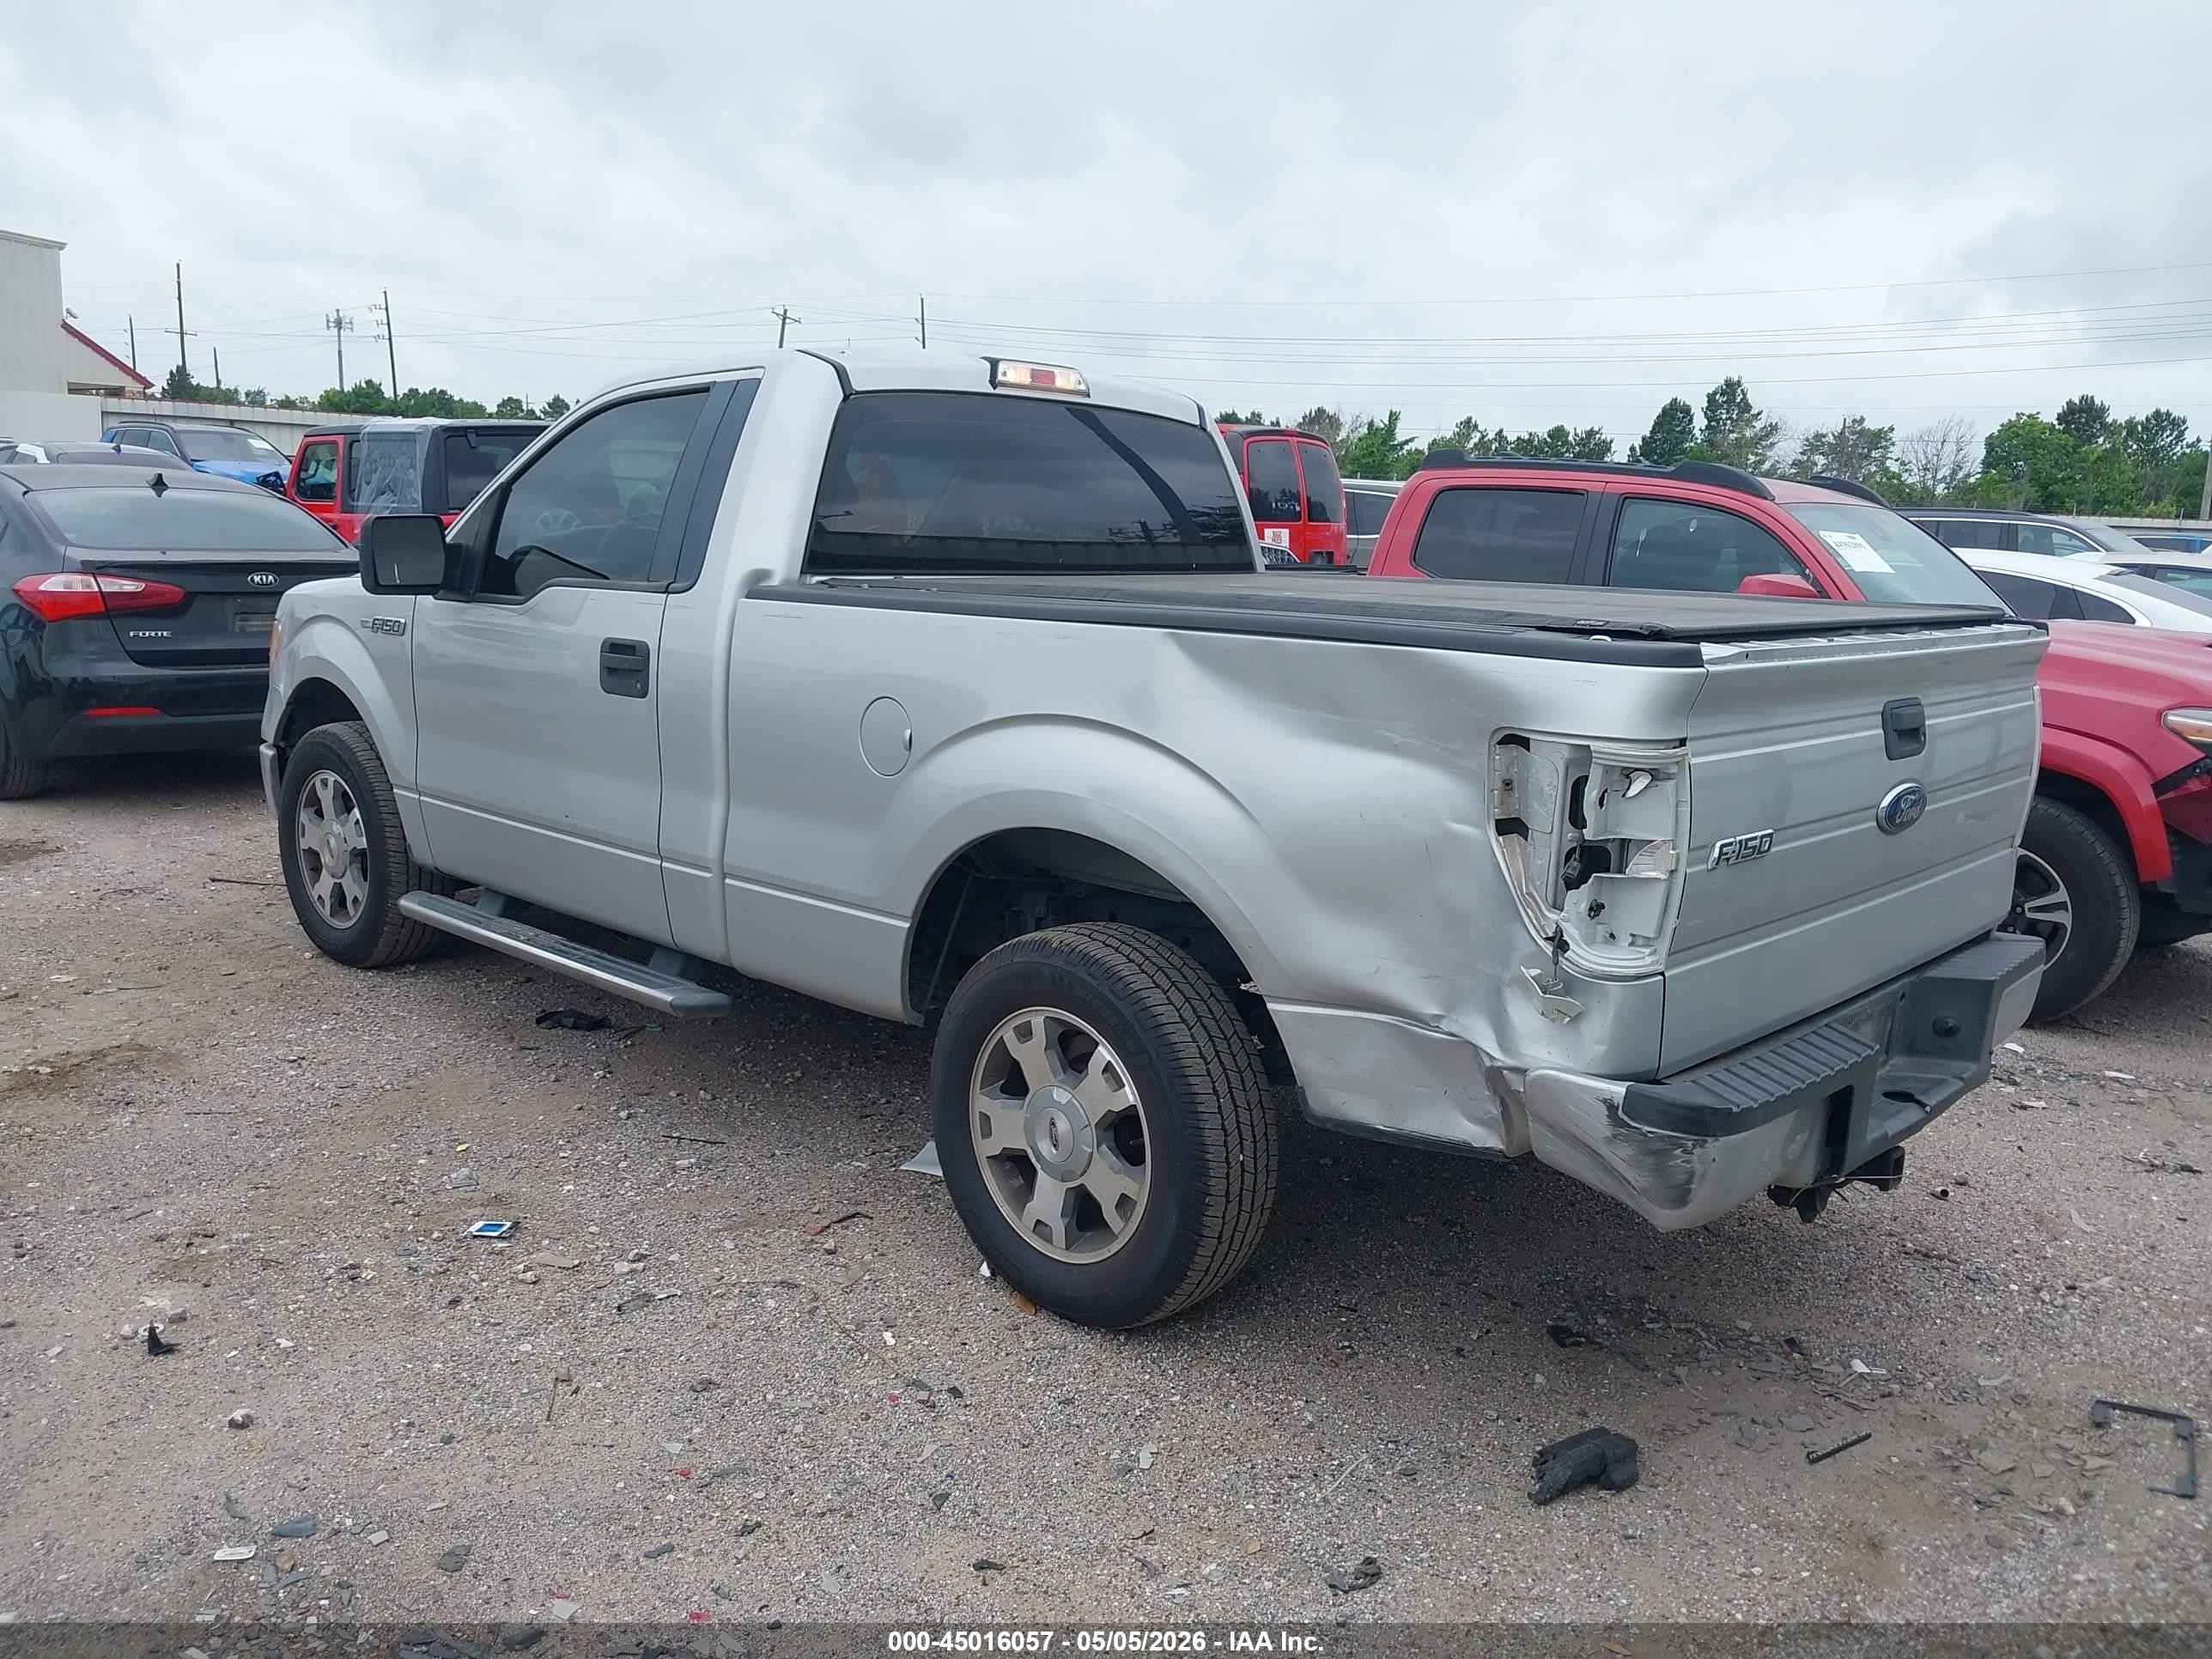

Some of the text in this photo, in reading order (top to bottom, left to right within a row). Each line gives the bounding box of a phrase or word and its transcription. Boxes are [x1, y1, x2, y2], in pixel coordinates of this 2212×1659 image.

[252, 574, 276, 585] KIA
[371, 617, 404, 634] F-150
[1711, 830, 1775, 866] F-150
